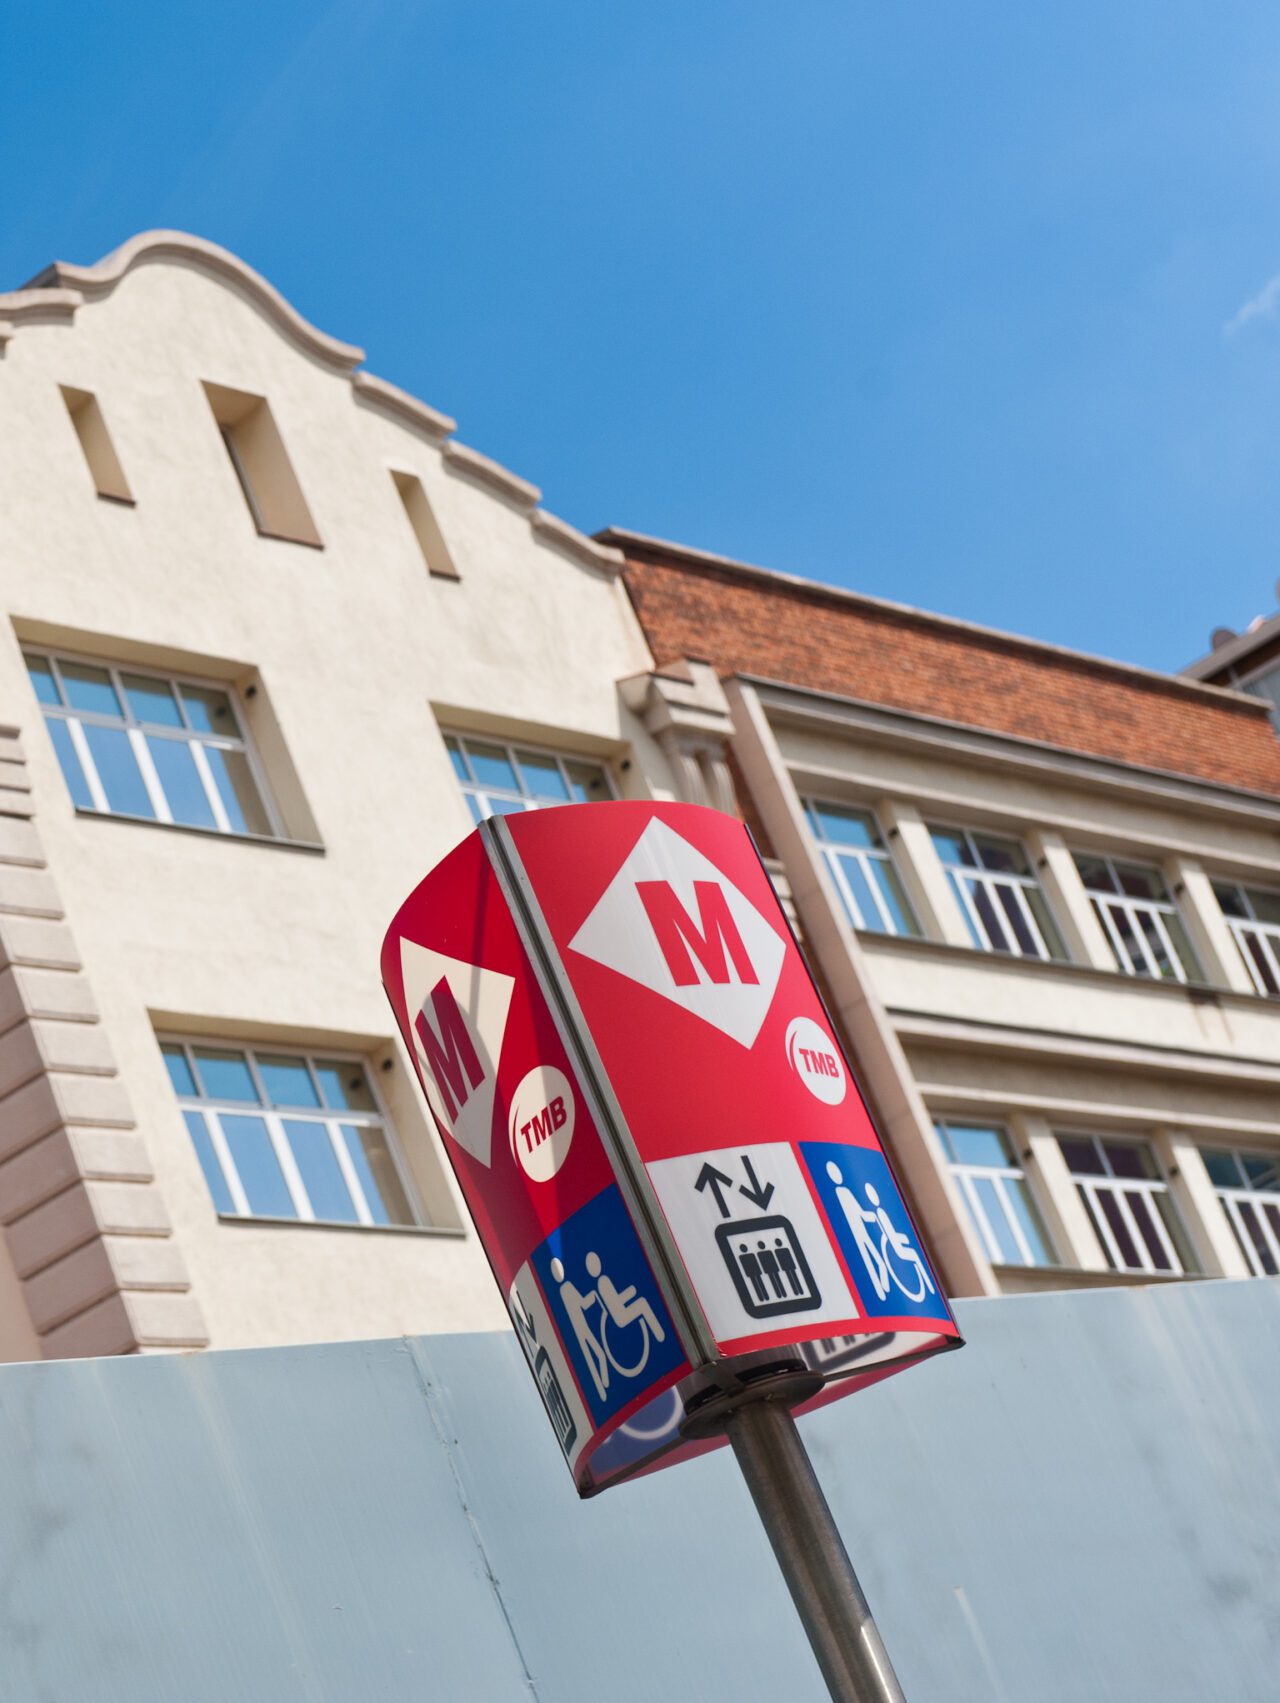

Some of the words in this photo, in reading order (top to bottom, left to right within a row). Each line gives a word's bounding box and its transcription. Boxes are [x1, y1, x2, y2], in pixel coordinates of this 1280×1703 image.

[634, 880, 760, 986] M
[414, 975, 485, 1125] M
[798, 1047, 840, 1078] TMB
[520, 1096, 567, 1154] TMB
